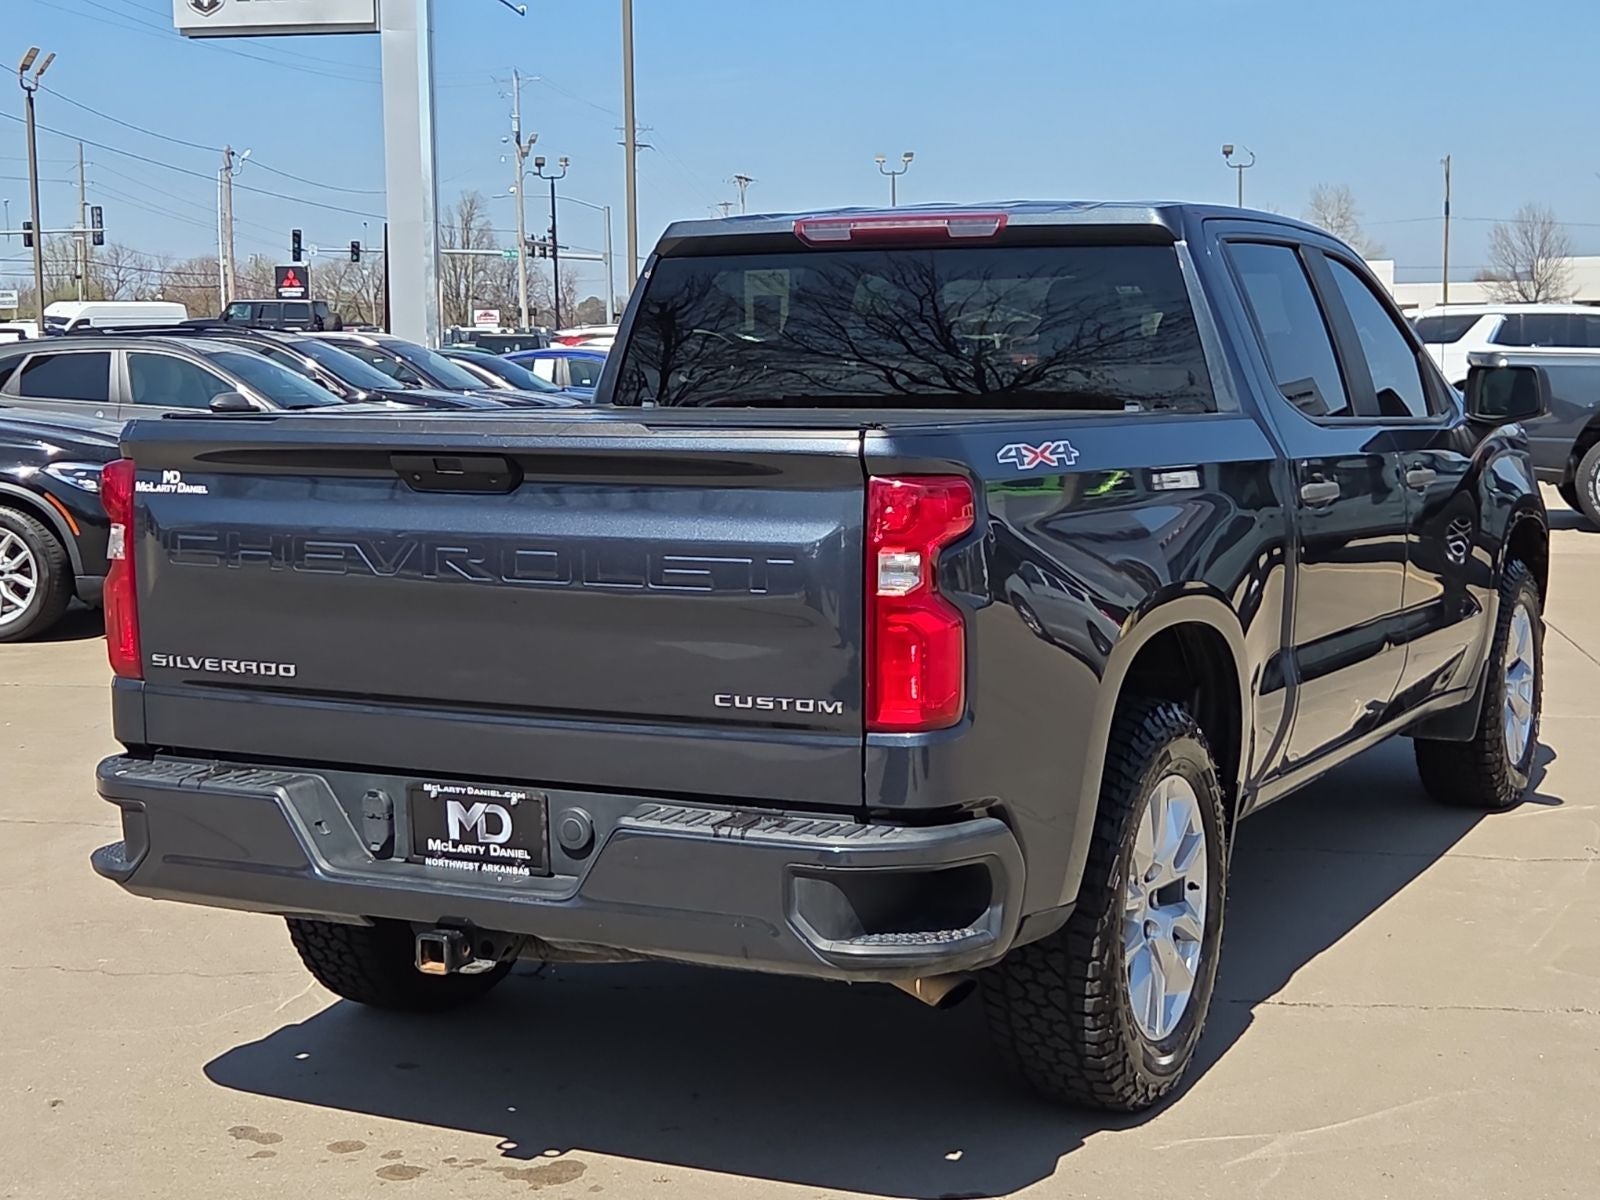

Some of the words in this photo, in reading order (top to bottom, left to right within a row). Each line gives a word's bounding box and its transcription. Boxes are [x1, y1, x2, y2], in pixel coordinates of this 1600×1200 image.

[163, 470, 180, 483] MD
[169, 530, 796, 594] CHEVROLET
[151, 653, 296, 677] SILVERADO
[714, 694, 843, 714] CUSTOM
[447, 800, 512, 843] MD
[489, 845, 531, 860] DANIEL
[425, 857, 479, 871] NORTHWEST
[481, 863, 530, 877] ARKANSAS
